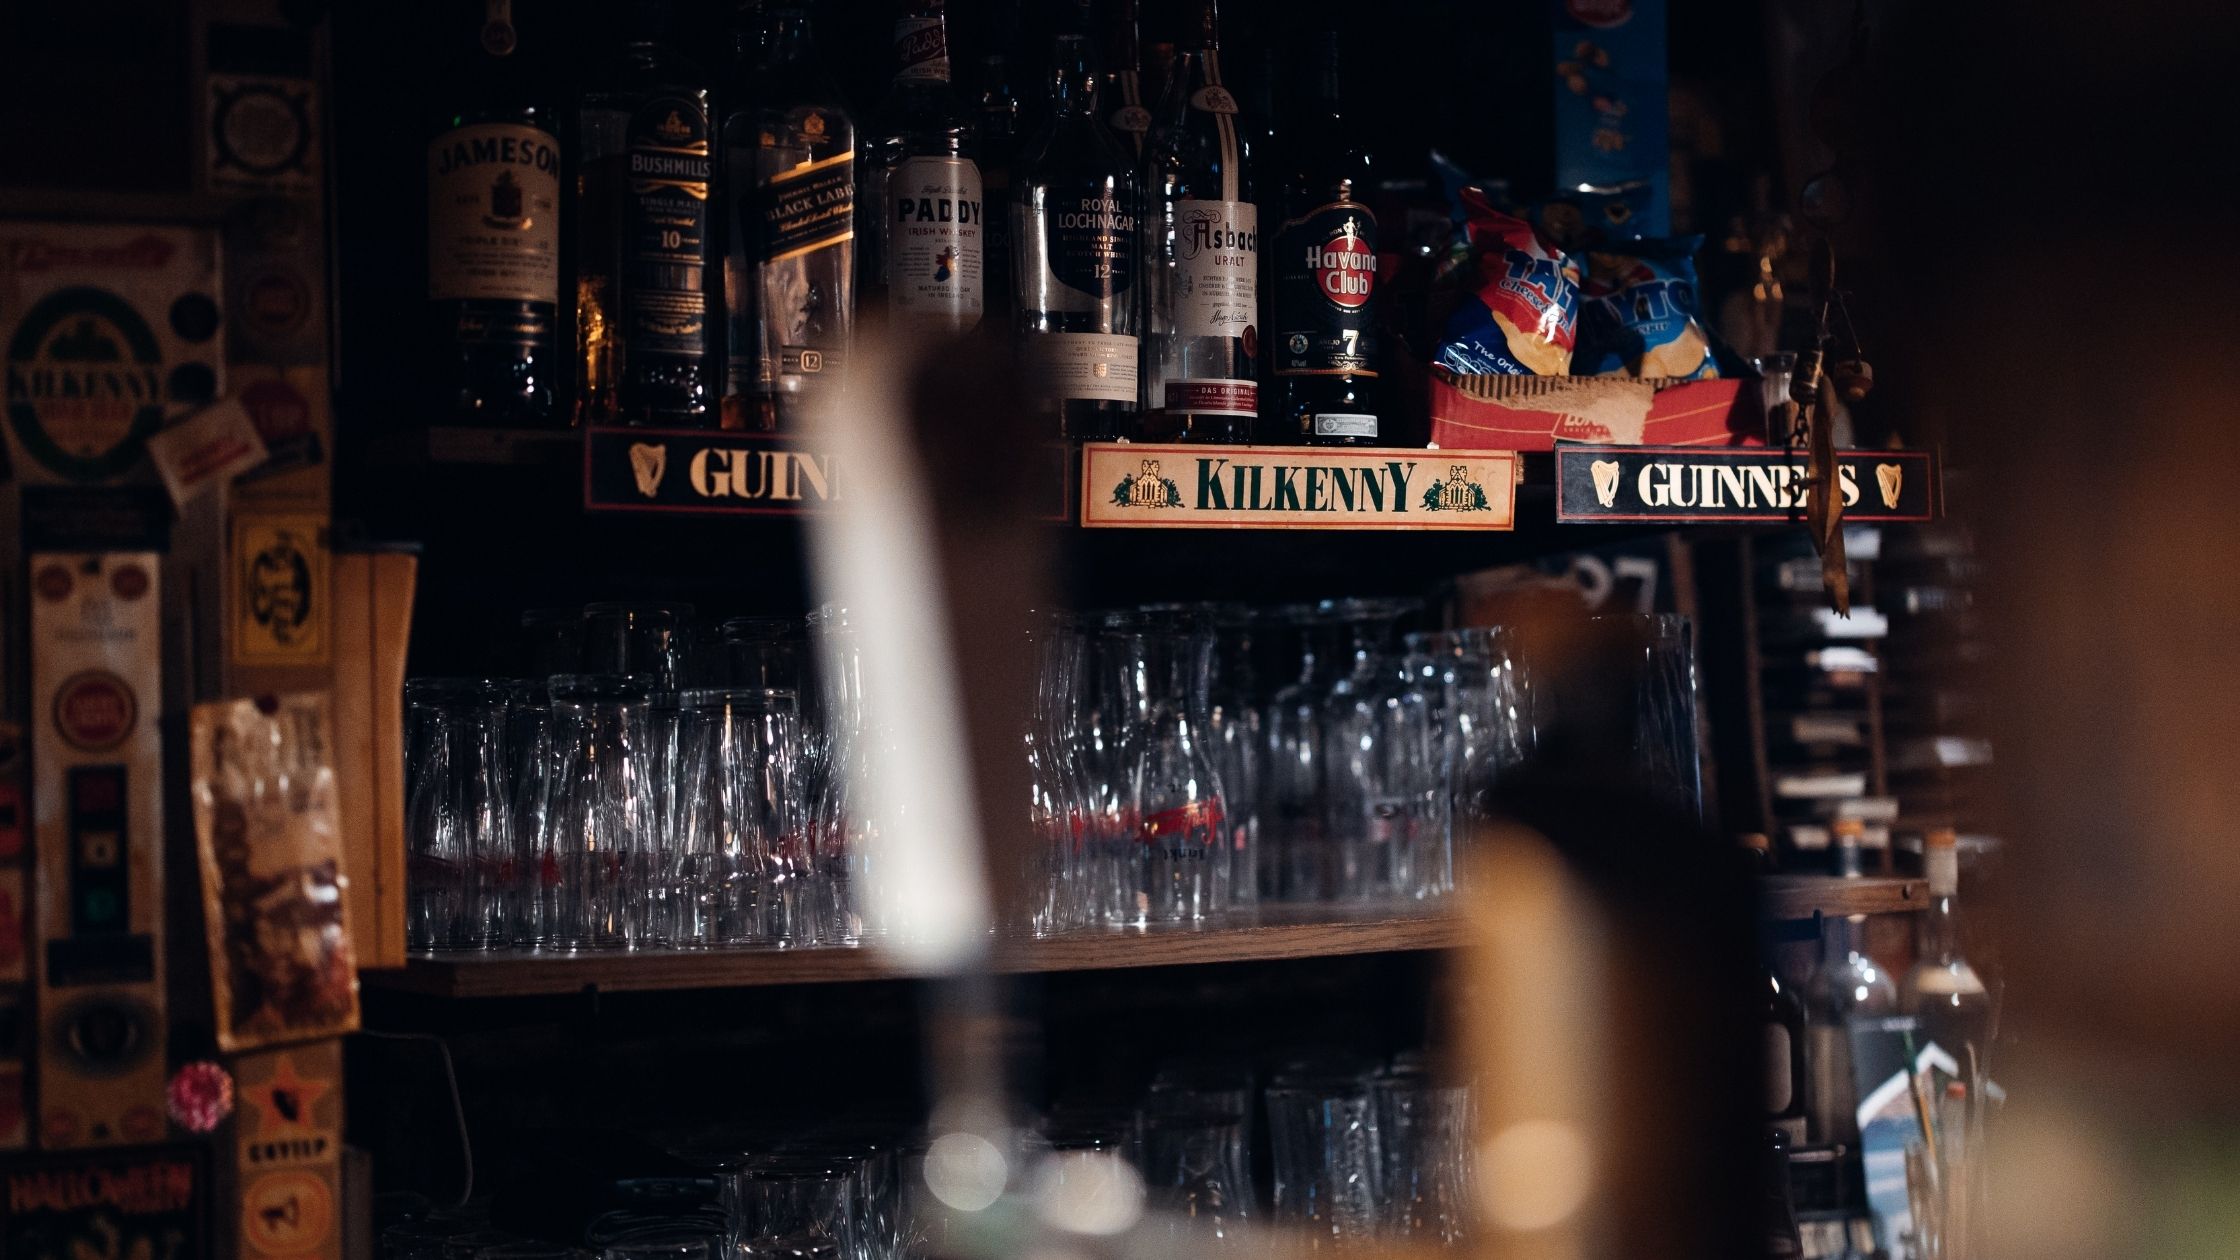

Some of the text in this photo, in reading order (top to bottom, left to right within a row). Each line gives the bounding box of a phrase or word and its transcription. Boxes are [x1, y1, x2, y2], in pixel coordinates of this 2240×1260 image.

[438, 136, 557, 178] JAMESON
[632, 154, 711, 178] BUSHMILLS
[898, 198, 980, 225] PADDY
[1081, 198, 1123, 213] ROYAL
[908, 228, 935, 236] IRISH
[1058, 213, 1134, 232] LOCHNAGAR
[661, 230, 681, 249] 10
[1186, 212, 1257, 258] Asbach
[1215, 255, 1245, 267] URALT
[1305, 245, 1376, 272] Havana
[1094, 264, 1111, 279] 12
[1325, 271, 1368, 295] Club
[1342, 328, 1360, 357] 7
[1474, 340, 1496, 360] The
[805, 354, 818, 367] 12
[1220, 387, 1250, 396] ORIGINAL
[689, 447, 843, 501] GUIN
[1193, 458, 1418, 513] KILKENNY
[1637, 463, 1860, 510] GUINNES
